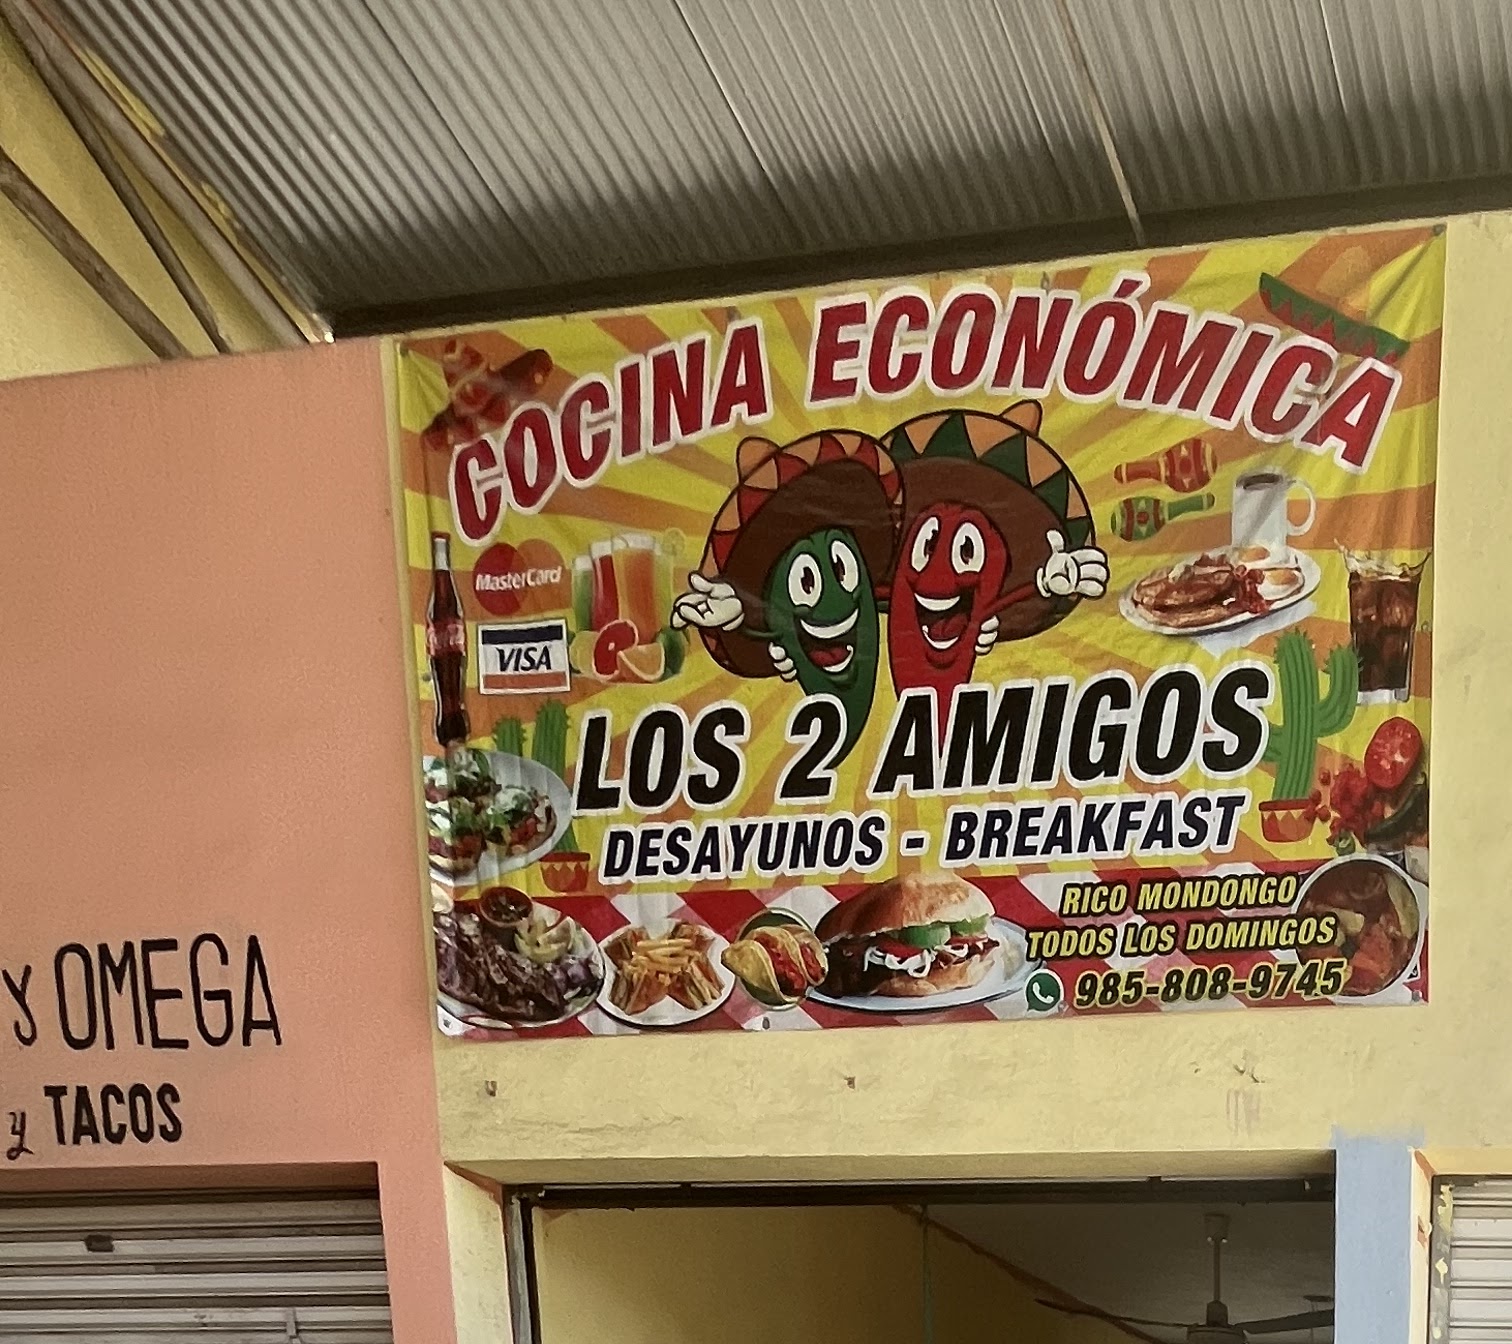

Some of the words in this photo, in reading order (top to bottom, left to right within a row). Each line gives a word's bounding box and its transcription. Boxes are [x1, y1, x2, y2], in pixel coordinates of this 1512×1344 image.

[454, 324, 768, 540] COCINA
[810, 277, 1400, 468] ECONÓMICA
[475, 565, 563, 592] MasterCard
[496, 645, 552, 672] VISA
[577, 709, 746, 808] LOS
[781, 702, 846, 798] 2
[874, 667, 1269, 793] AMIGOS
[603, 818, 885, 878] DESAYUNOS
[944, 796, 1247, 860] BREAKFAST
[1063, 884, 1127, 915] RICO
[1137, 875, 1298, 912] MONDONGO
[1027, 928, 1115, 958] TODOS
[1122, 924, 1175, 954] LOS
[1185, 916, 1336, 950] DOMINGOS
[54, 932, 283, 1051] OMEGA
[1075, 959, 1346, 1008] 985-808-9745
[44, 1083, 182, 1146] TACOS
